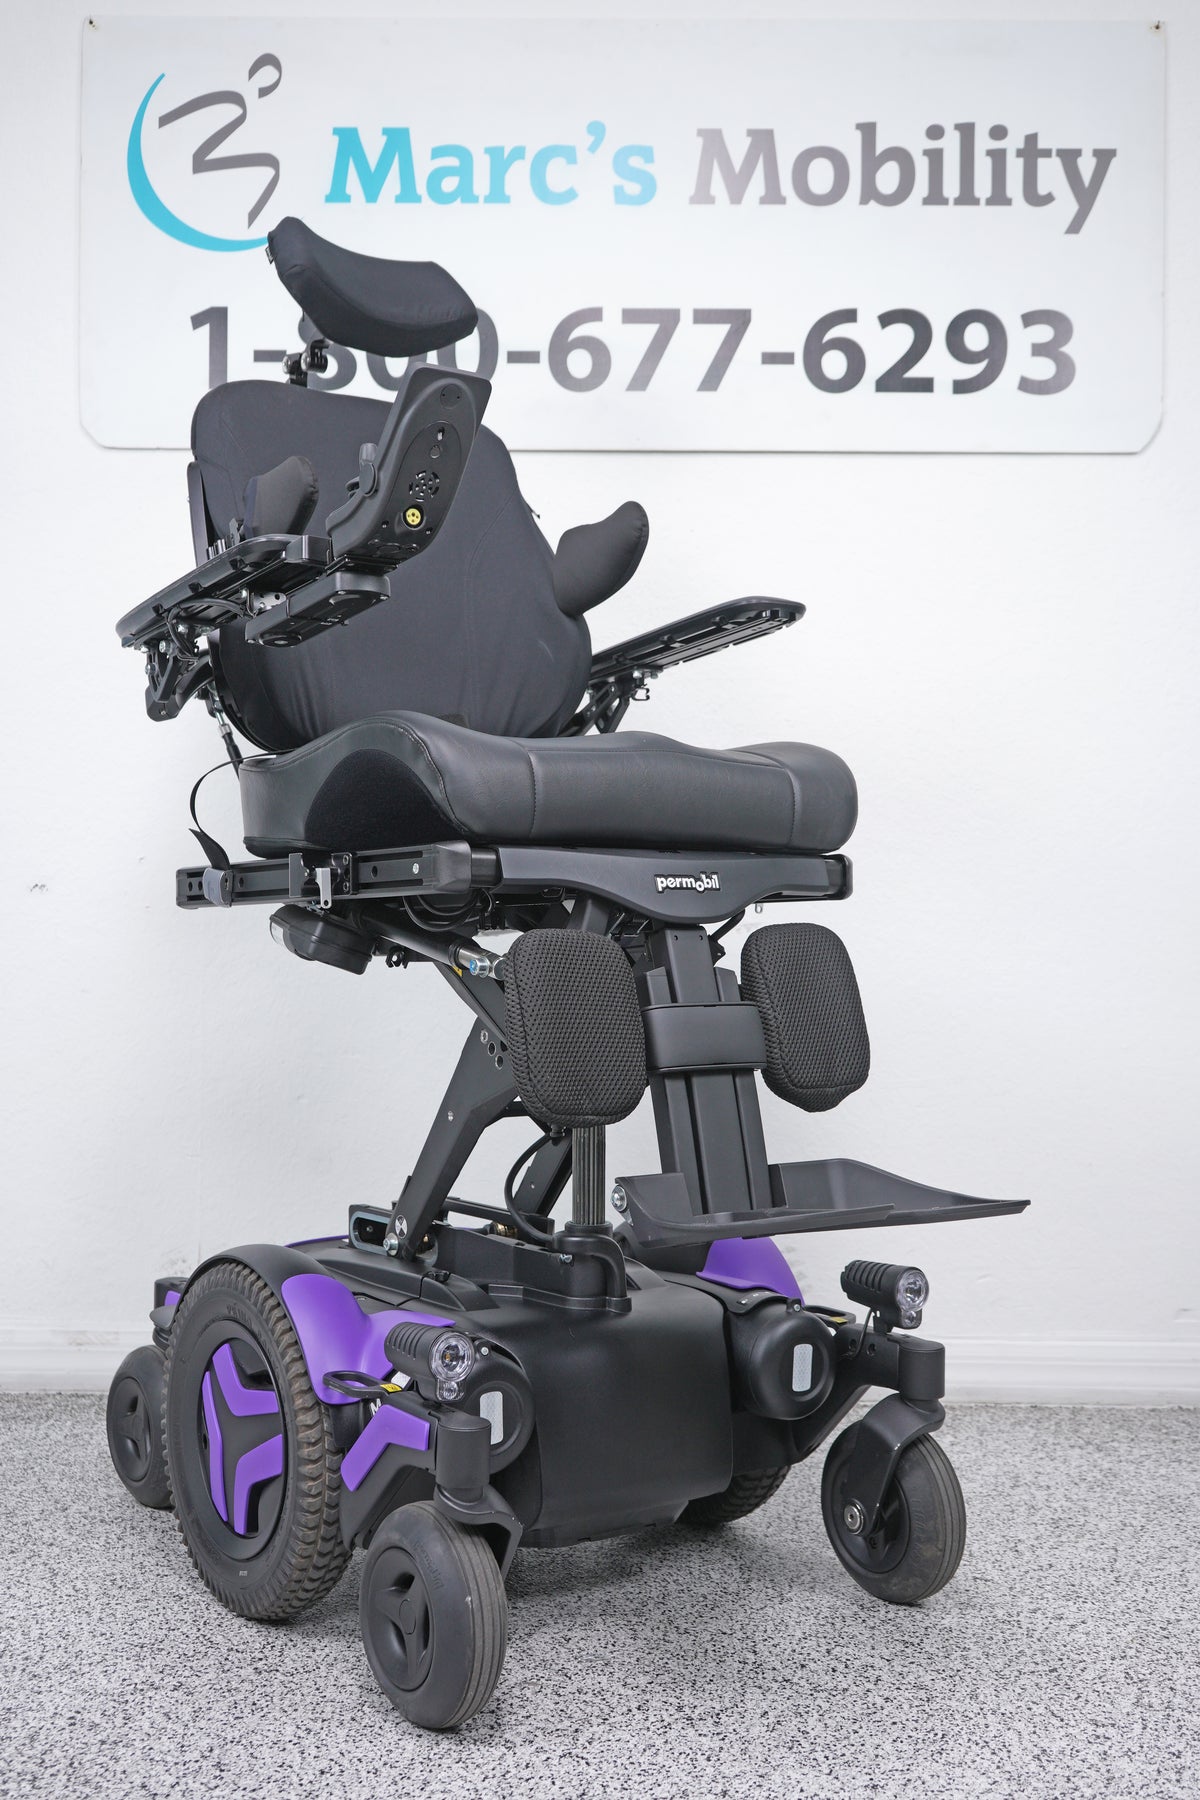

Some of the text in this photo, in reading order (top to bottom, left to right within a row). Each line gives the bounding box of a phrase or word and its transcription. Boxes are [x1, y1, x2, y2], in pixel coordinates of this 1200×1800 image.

[324, 120, 1118, 235] Marc’s Mobility
[655, 873, 720, 892] permobil
